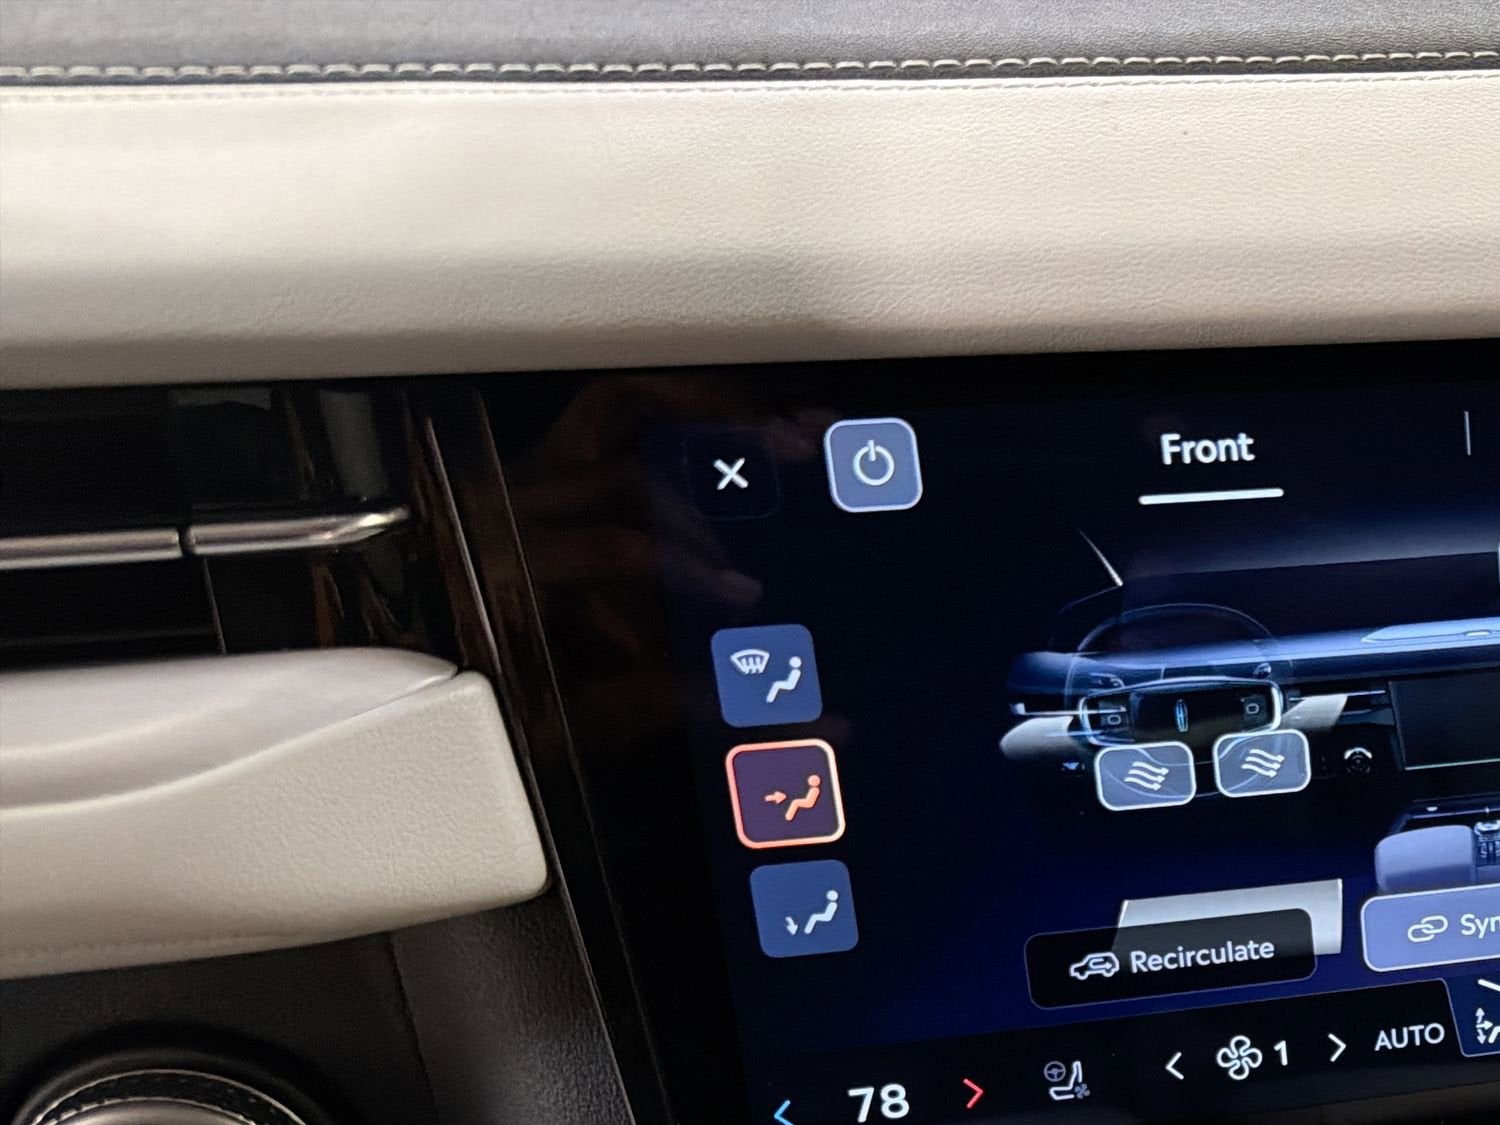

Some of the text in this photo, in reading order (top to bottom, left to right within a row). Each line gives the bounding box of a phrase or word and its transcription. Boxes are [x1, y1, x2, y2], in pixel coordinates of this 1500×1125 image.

[1160, 433, 1255, 465] Front
[1130, 938, 1274, 973] Recirculate
[1374, 1022, 1446, 1052] AUTO
[1273, 1040, 1289, 1067] 1
[849, 1084, 911, 1124] 78
